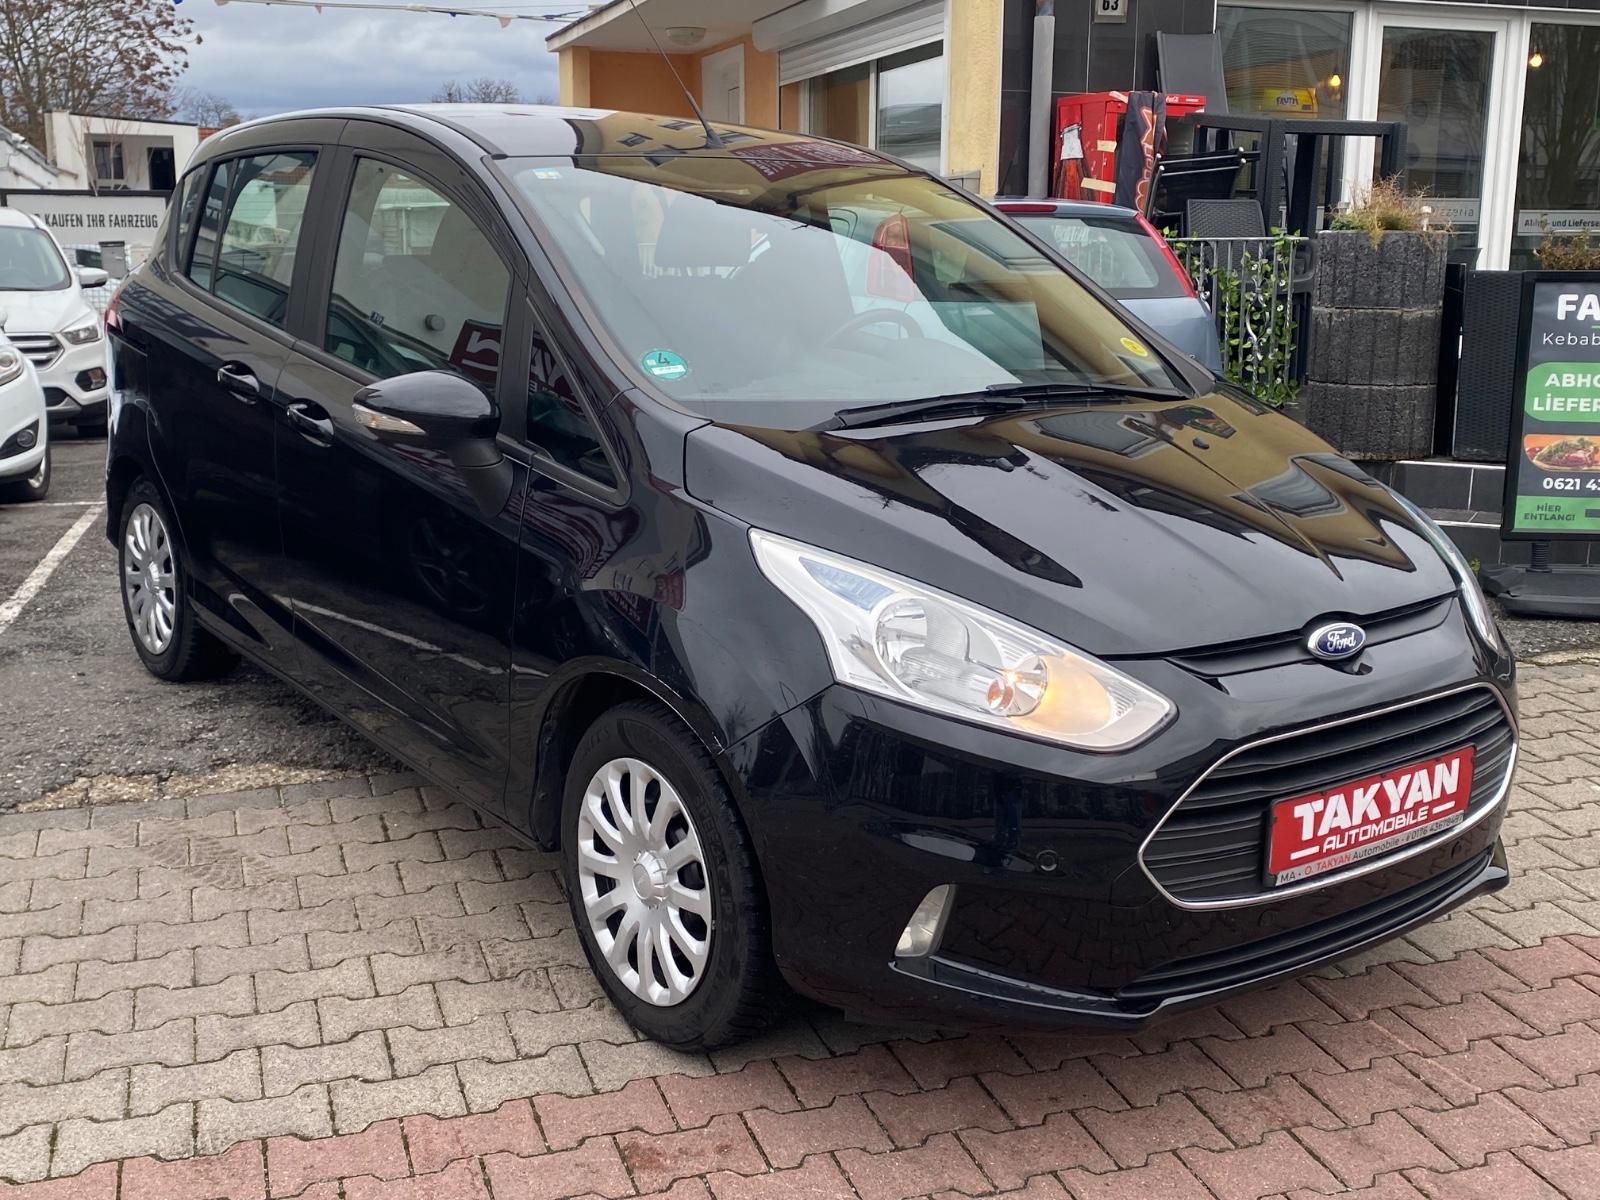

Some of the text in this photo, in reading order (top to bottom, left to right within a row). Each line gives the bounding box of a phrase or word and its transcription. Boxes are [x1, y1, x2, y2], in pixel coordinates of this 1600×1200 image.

[44, 213, 83, 228] KAUFEN
[86, 214, 106, 228] IHR
[109, 214, 158, 228] FAHRZEUG
[1552, 219, 1567, 227] und
[1557, 294, 1600, 321] FA
[1542, 332, 1600, 346] Kebab
[658, 352, 670, 364] 4
[1542, 477, 1581, 490] 0621
[1524, 512, 1576, 521] ENTLANG!
[1327, 629, 1357, 652] Ford
[1293, 757, 1461, 842] TAKYAN
[1322, 805, 1430, 853] AUTOMOBILE
[1280, 871, 1296, 883] MA
[1317, 854, 1352, 871] TAKYAN
[1352, 837, 1401, 860] Automobile
